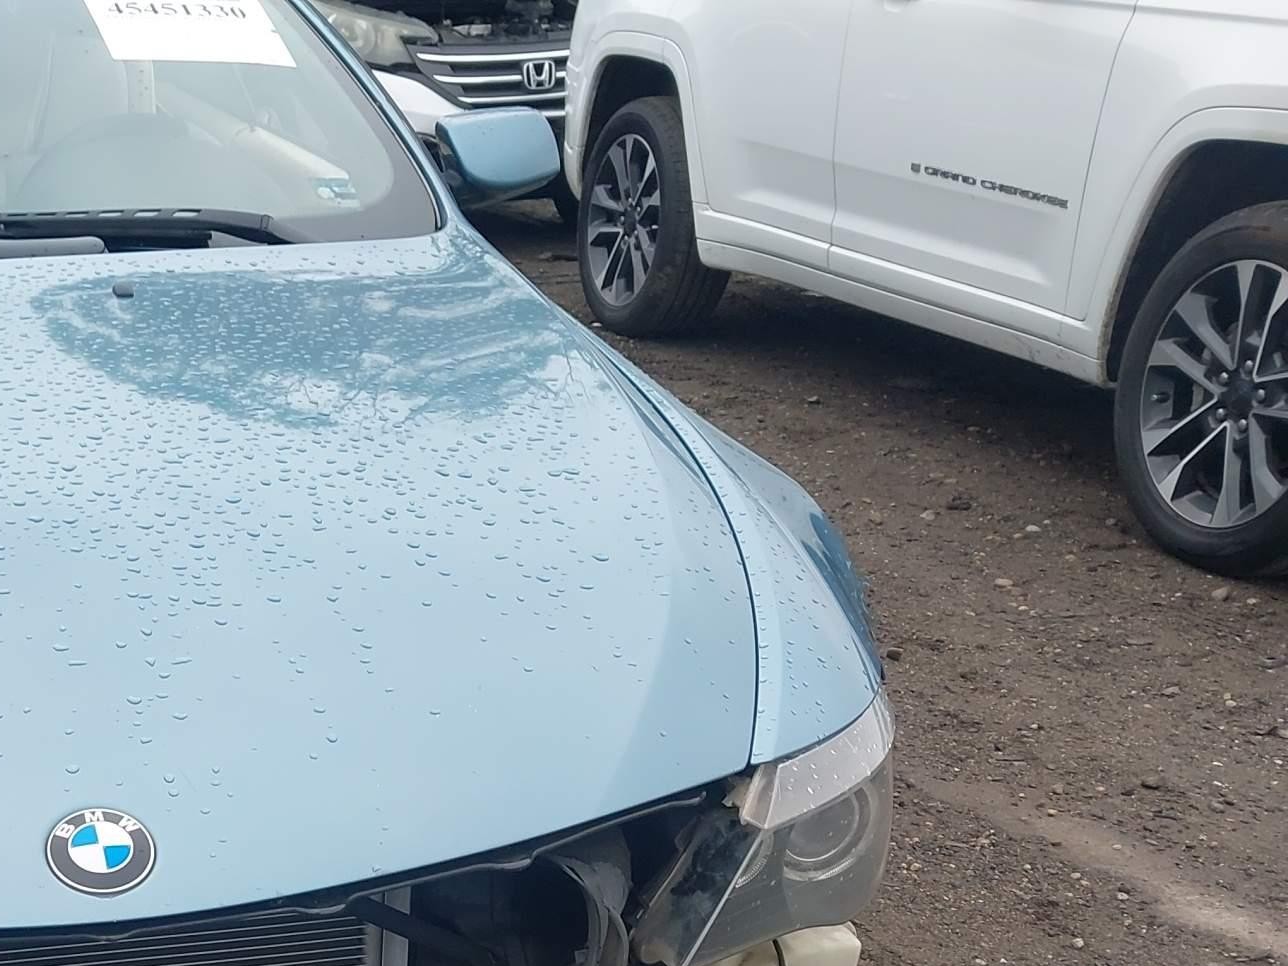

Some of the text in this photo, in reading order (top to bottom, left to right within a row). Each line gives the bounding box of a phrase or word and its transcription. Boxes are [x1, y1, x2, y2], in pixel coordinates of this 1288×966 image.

[108, 2, 247, 19] 45451330
[924, 165, 1069, 210] GRAND CHEROKEE
[53, 810, 141, 839] BMW
